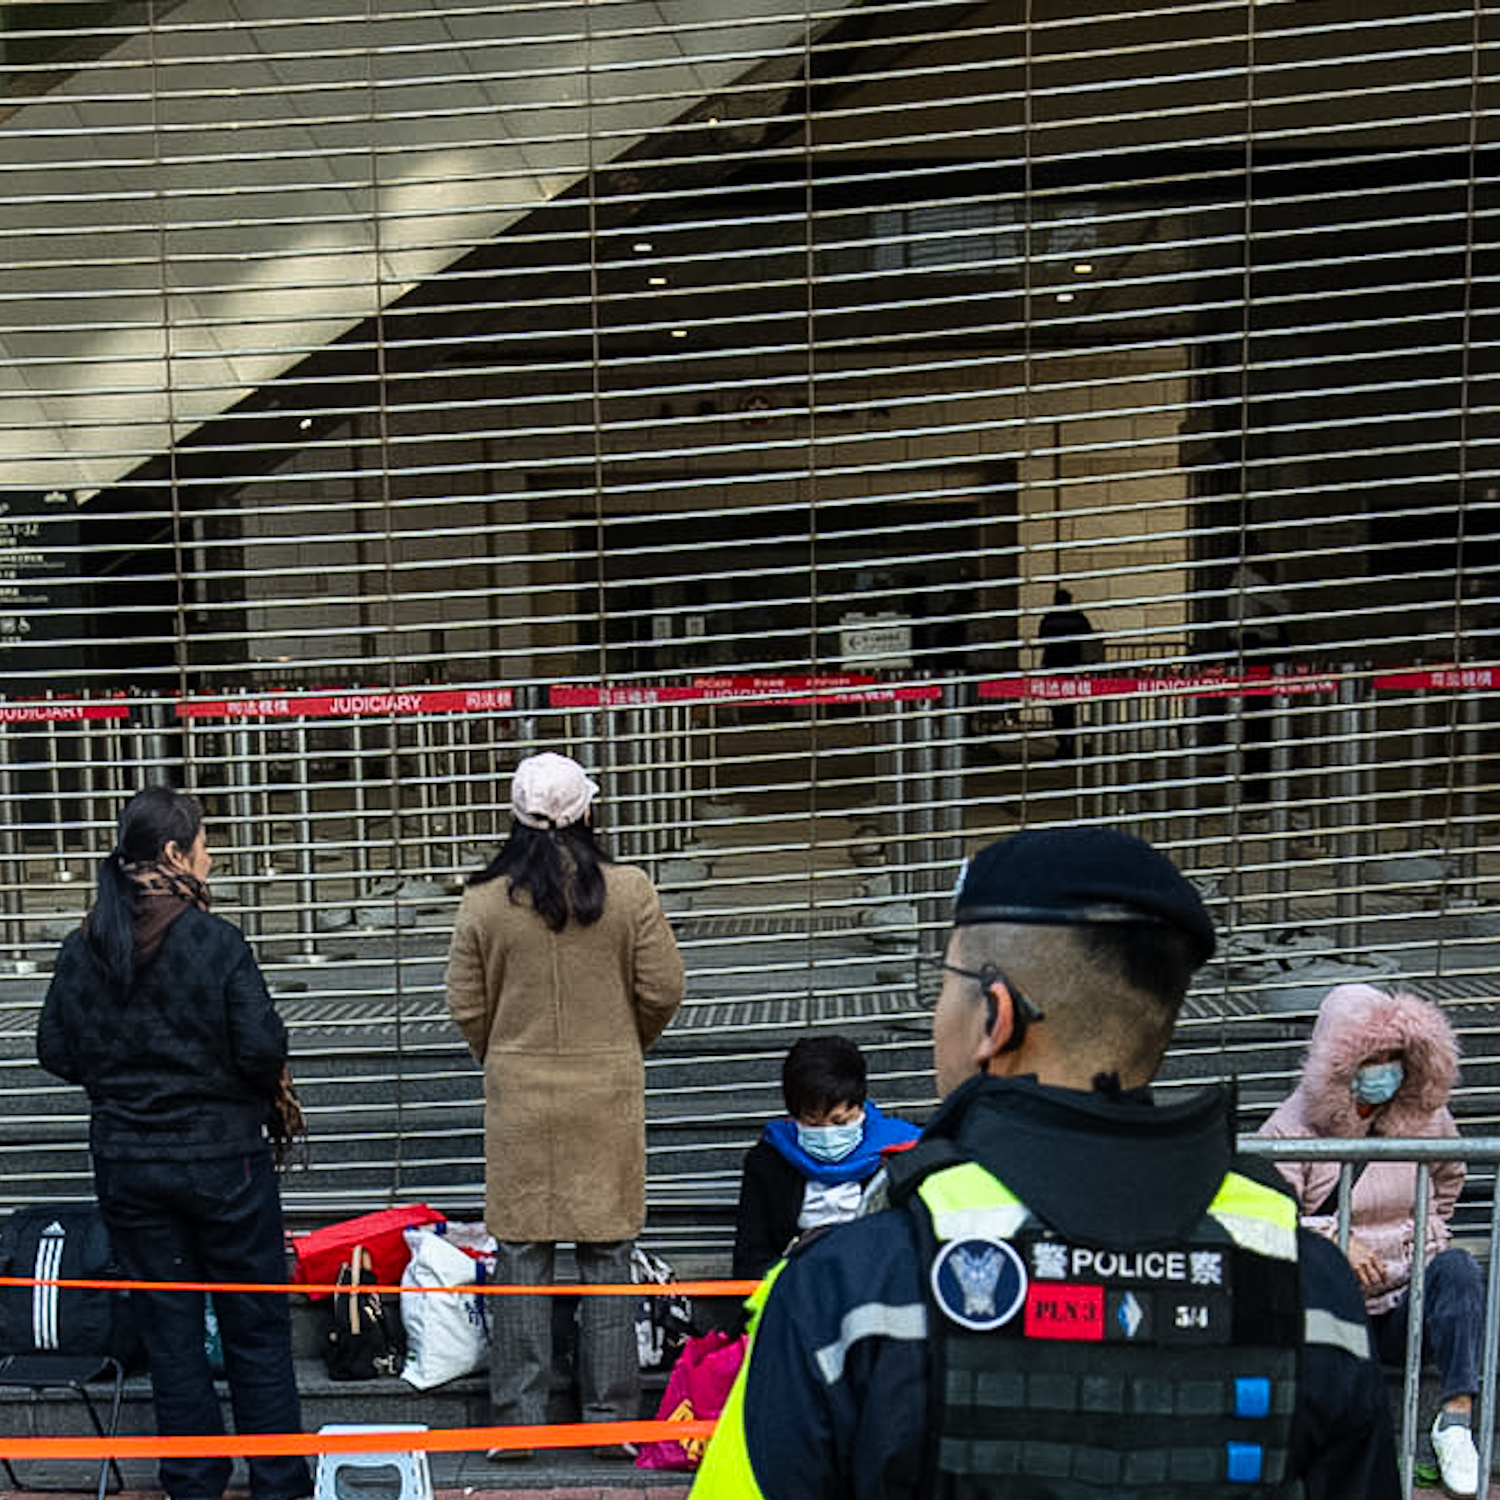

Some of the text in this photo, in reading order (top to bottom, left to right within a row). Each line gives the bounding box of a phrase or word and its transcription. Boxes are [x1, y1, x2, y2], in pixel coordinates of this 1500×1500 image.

[329, 695, 421, 713] JUDICIARY
[1033, 1243, 1222, 1284] 警 POLICE 察
